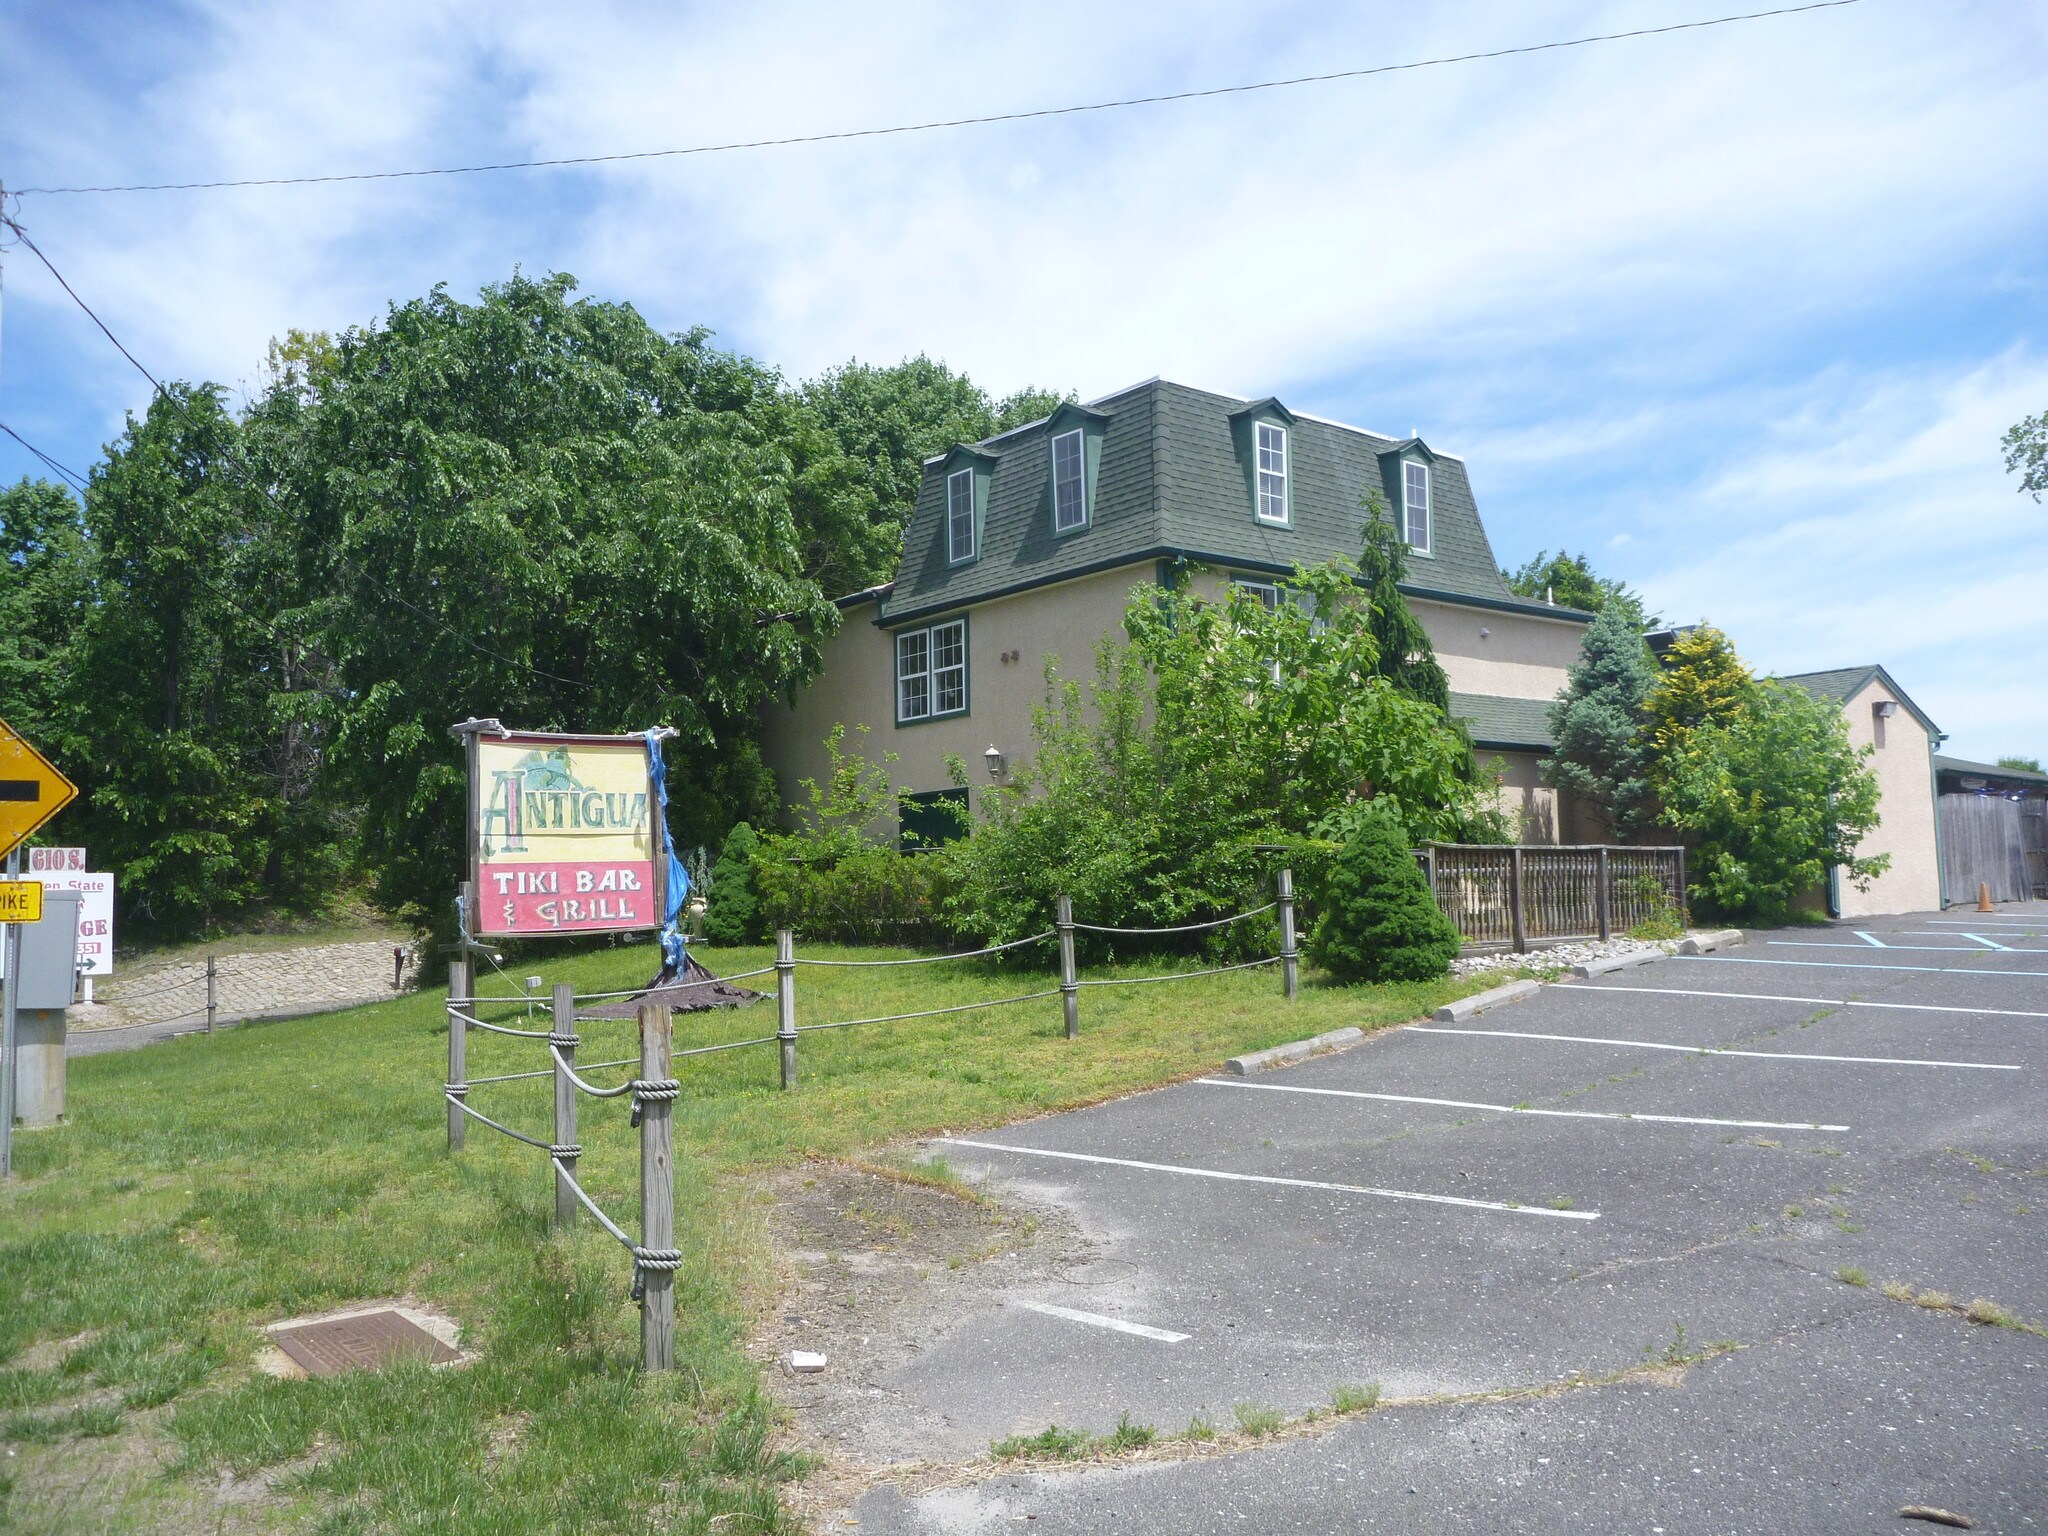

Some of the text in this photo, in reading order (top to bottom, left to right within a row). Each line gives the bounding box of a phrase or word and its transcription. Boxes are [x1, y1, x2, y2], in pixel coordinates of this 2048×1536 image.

[481, 770, 648, 856] ANTIGUA
[32, 849, 84, 871] 610 S.
[69, 880, 104, 891] State
[493, 869, 642, 895] TIKI BAR
[503, 898, 635, 927] & GRILL
